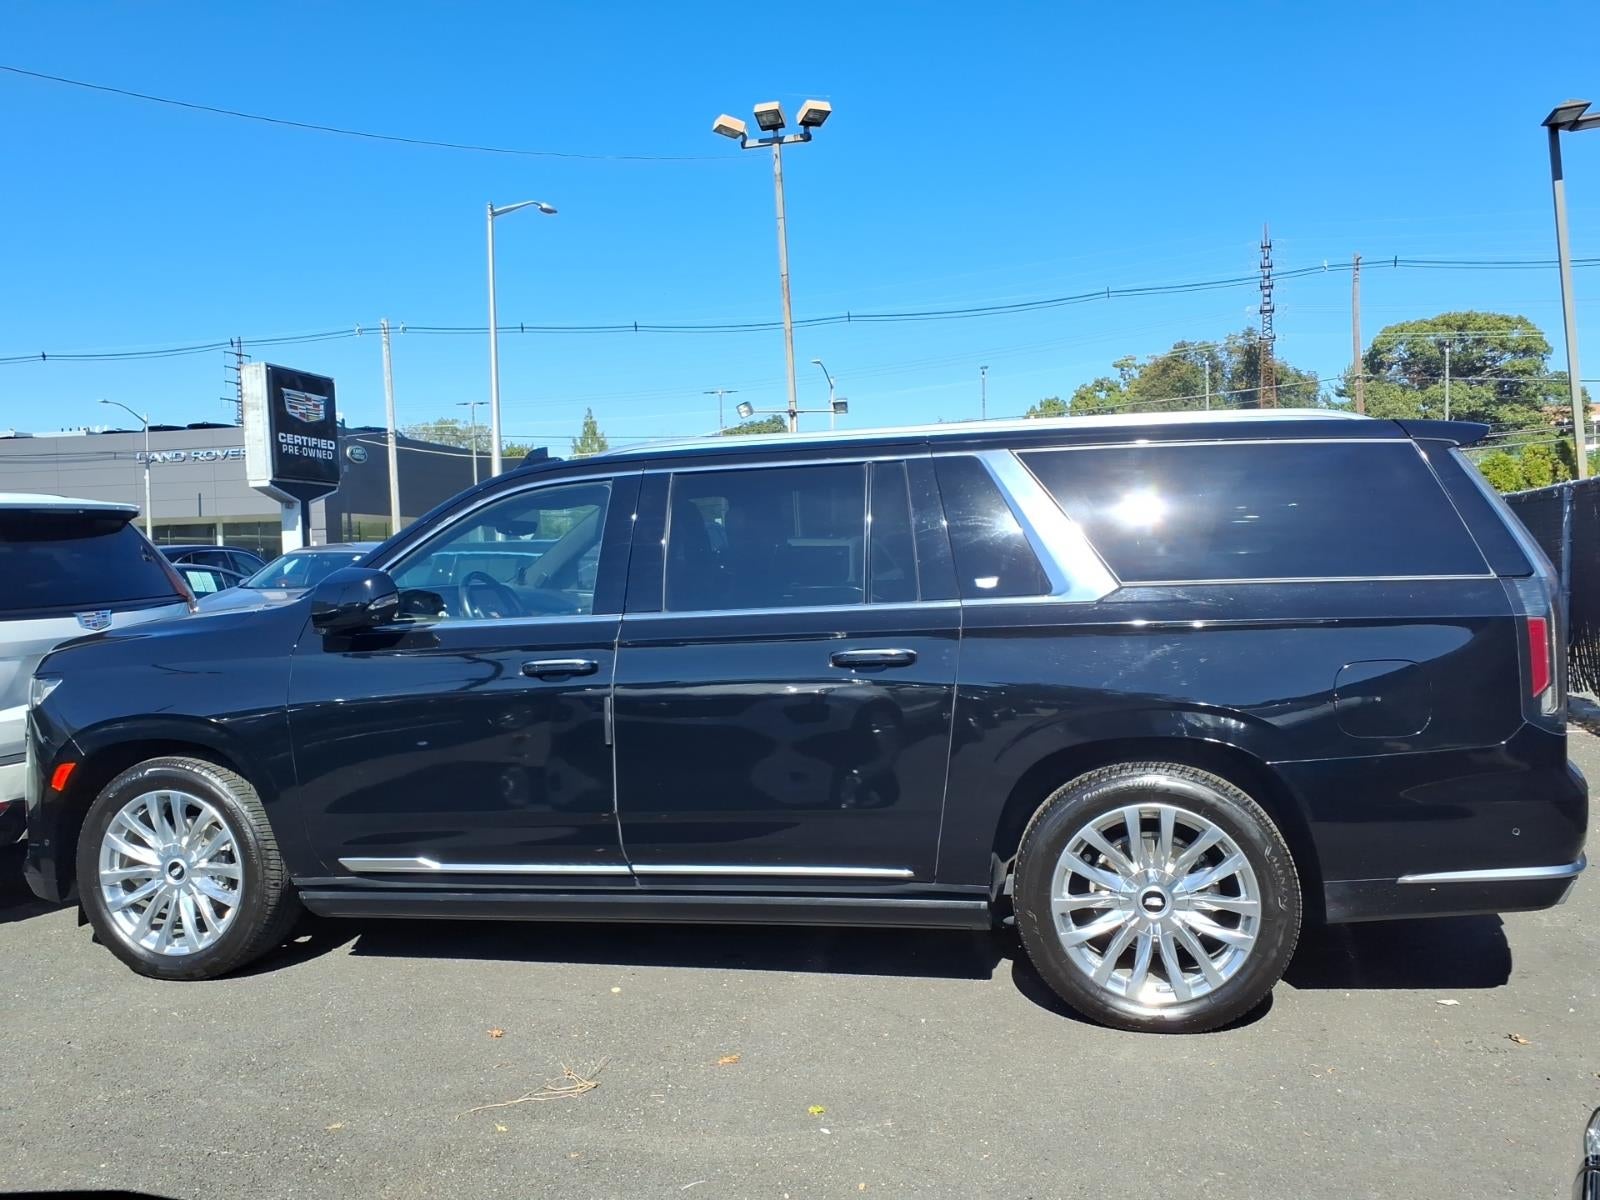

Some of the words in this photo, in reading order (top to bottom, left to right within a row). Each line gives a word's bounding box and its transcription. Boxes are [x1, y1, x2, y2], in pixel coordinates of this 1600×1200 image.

[278, 432, 336, 450] CERTIFIED
[136, 451, 187, 464] LAND
[282, 444, 333, 460] PRE-OWNED
